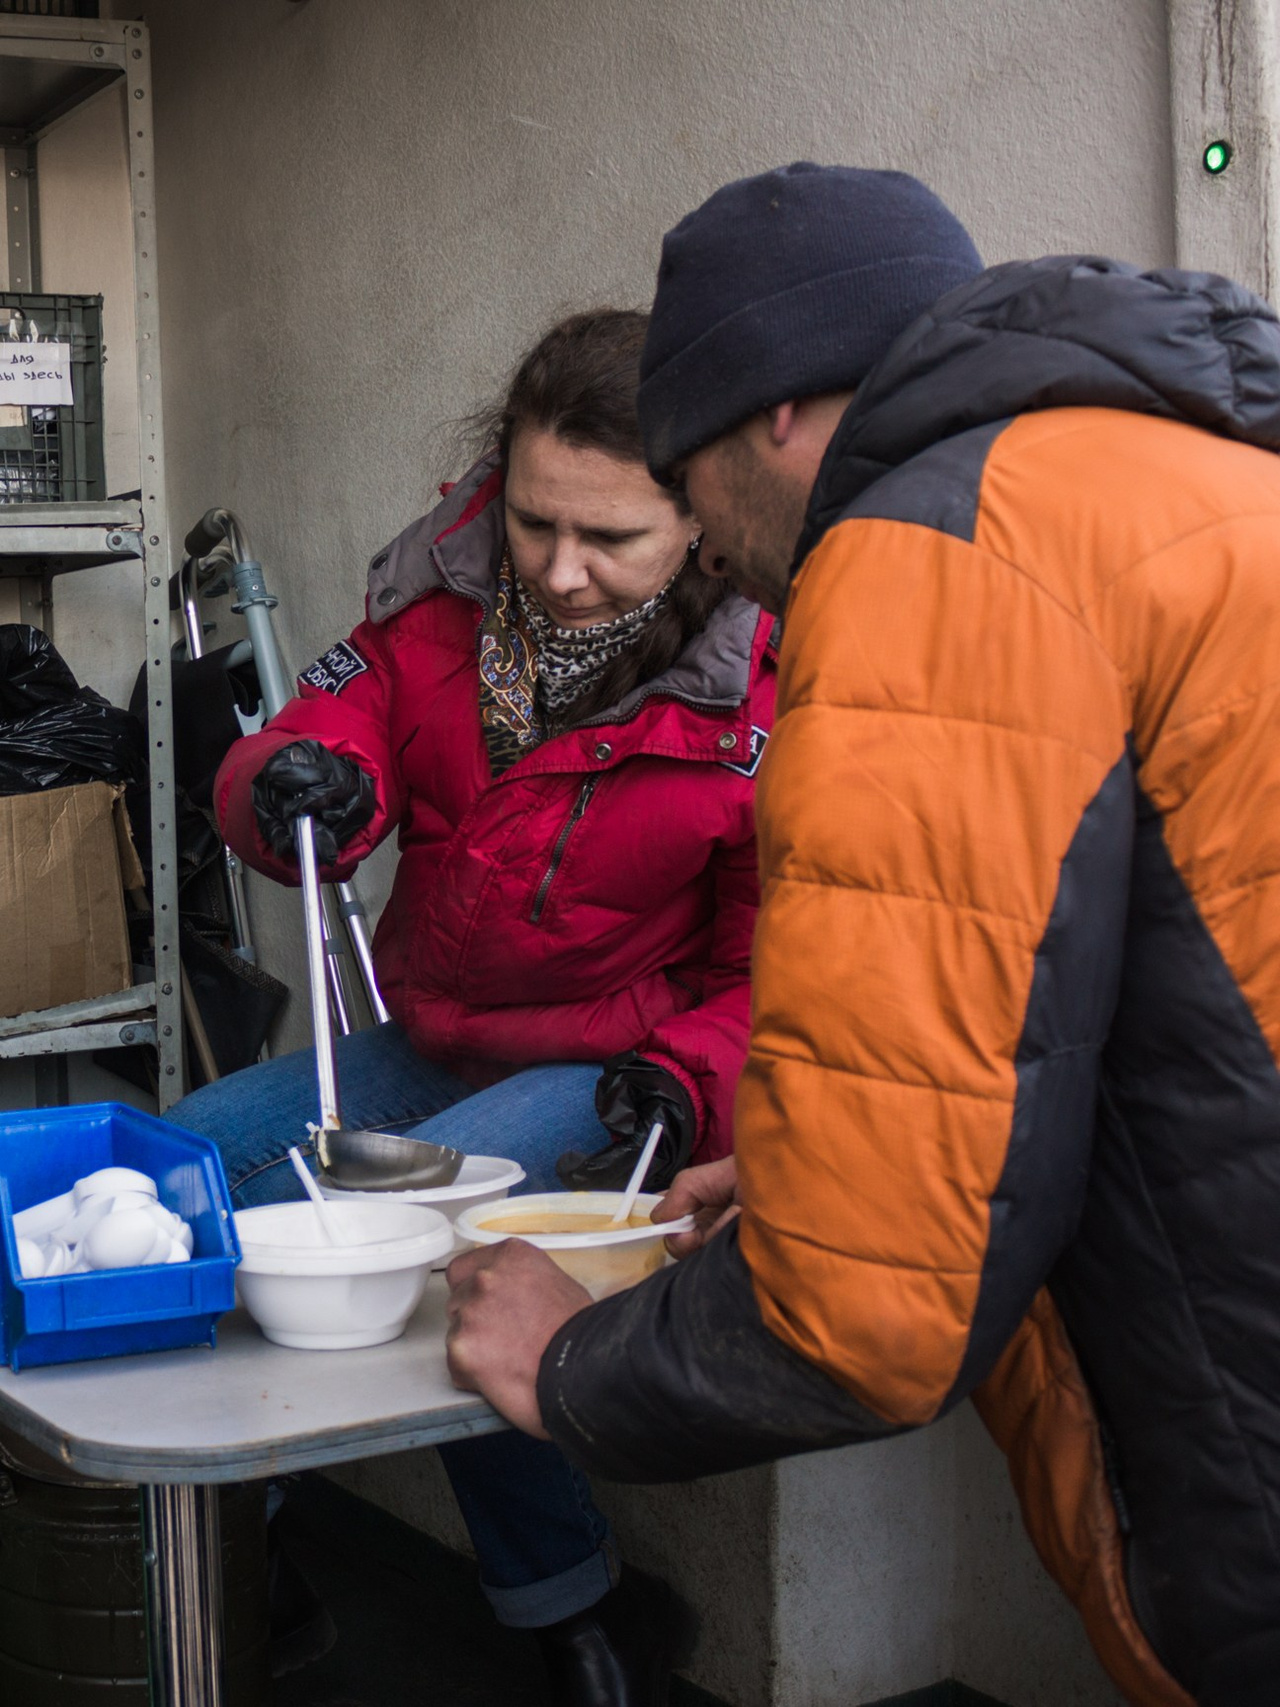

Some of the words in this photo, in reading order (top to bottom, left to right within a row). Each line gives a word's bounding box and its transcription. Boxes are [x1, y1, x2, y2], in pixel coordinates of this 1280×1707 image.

[10, 354, 35, 366] для
[23, 371, 63, 381] здесь
[306, 661, 337, 690] ОБУС
